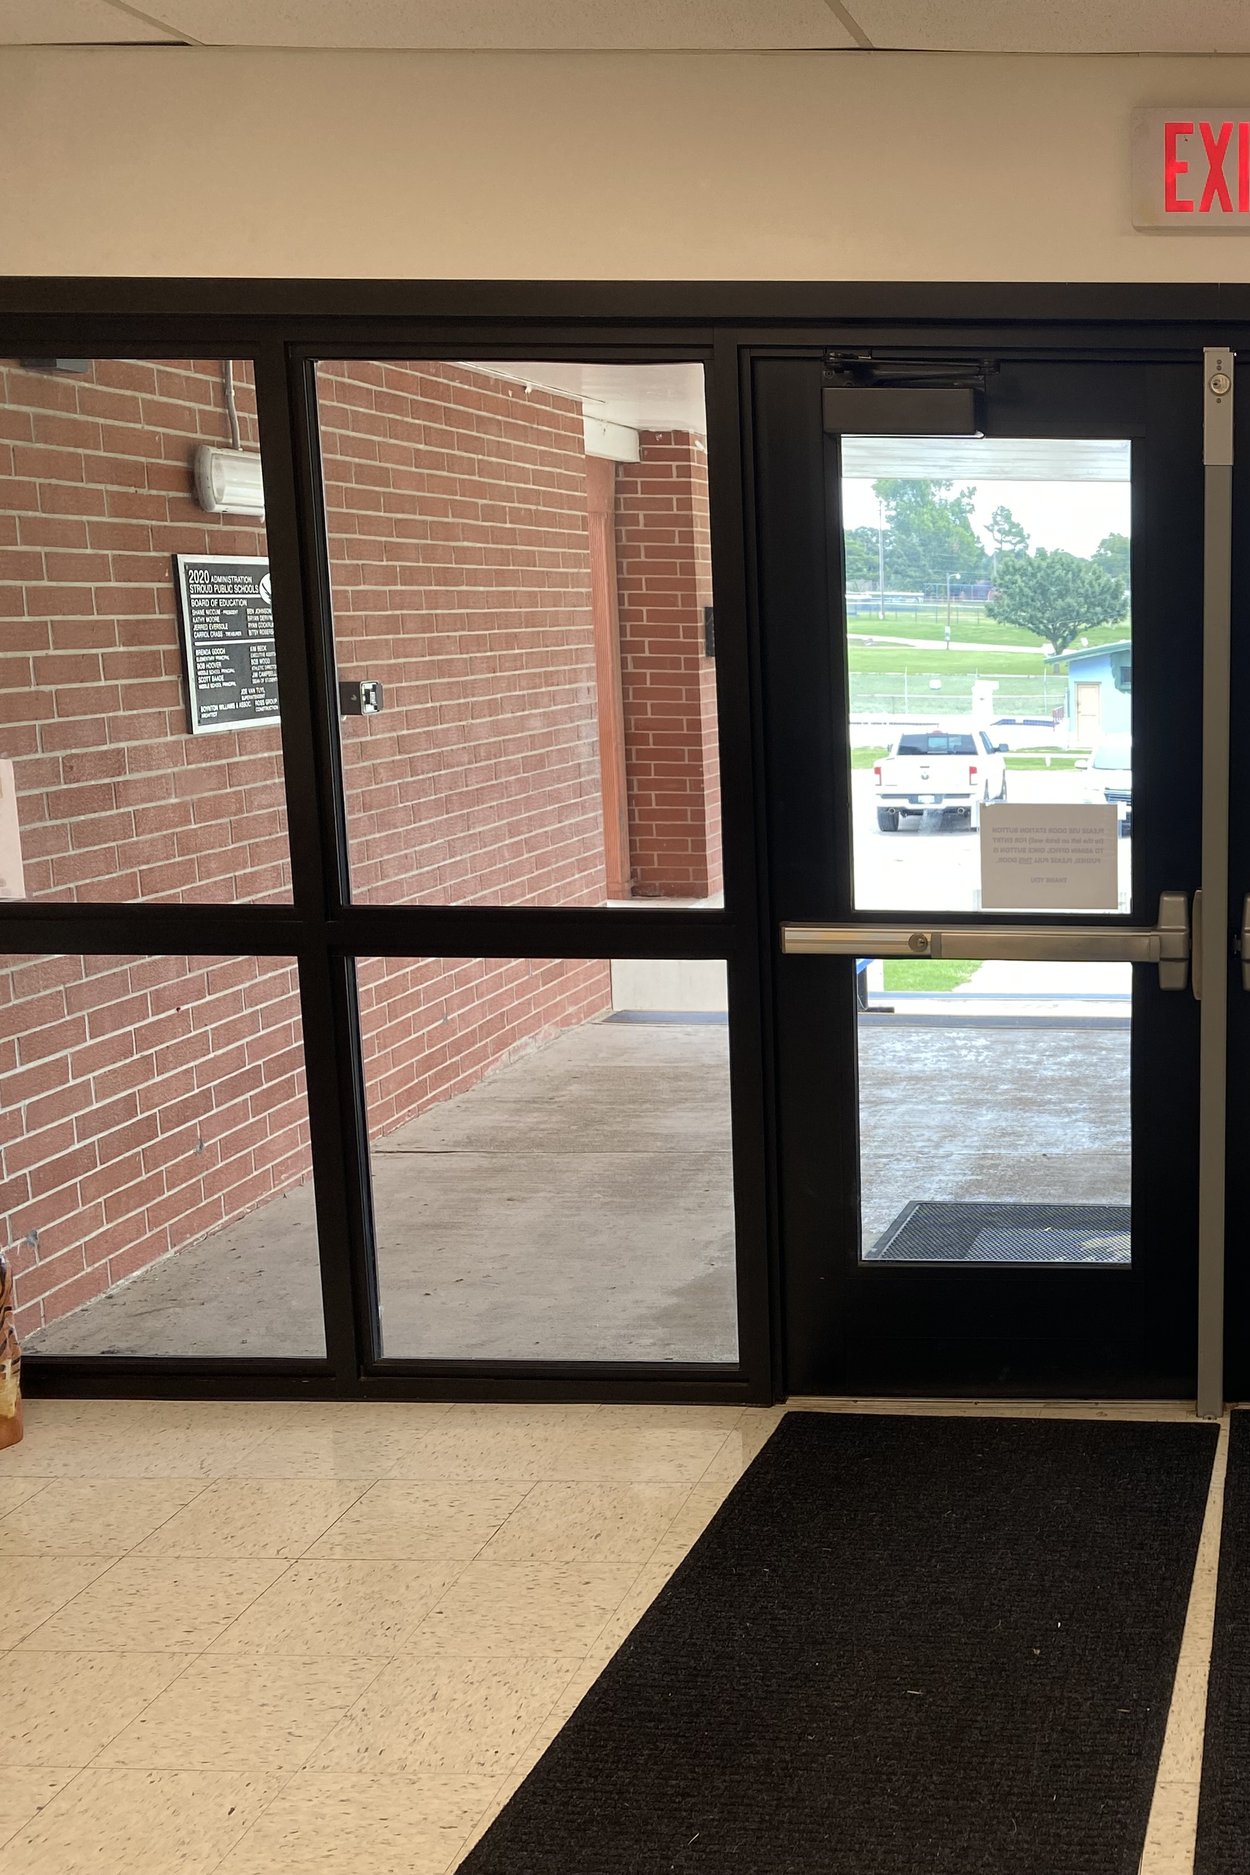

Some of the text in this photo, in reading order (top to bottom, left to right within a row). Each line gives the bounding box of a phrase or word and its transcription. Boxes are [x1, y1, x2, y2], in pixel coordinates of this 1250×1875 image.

[189, 570, 209, 583] 2020
[190, 584, 258, 593] STROUD PUBLIC SCHOOLS
